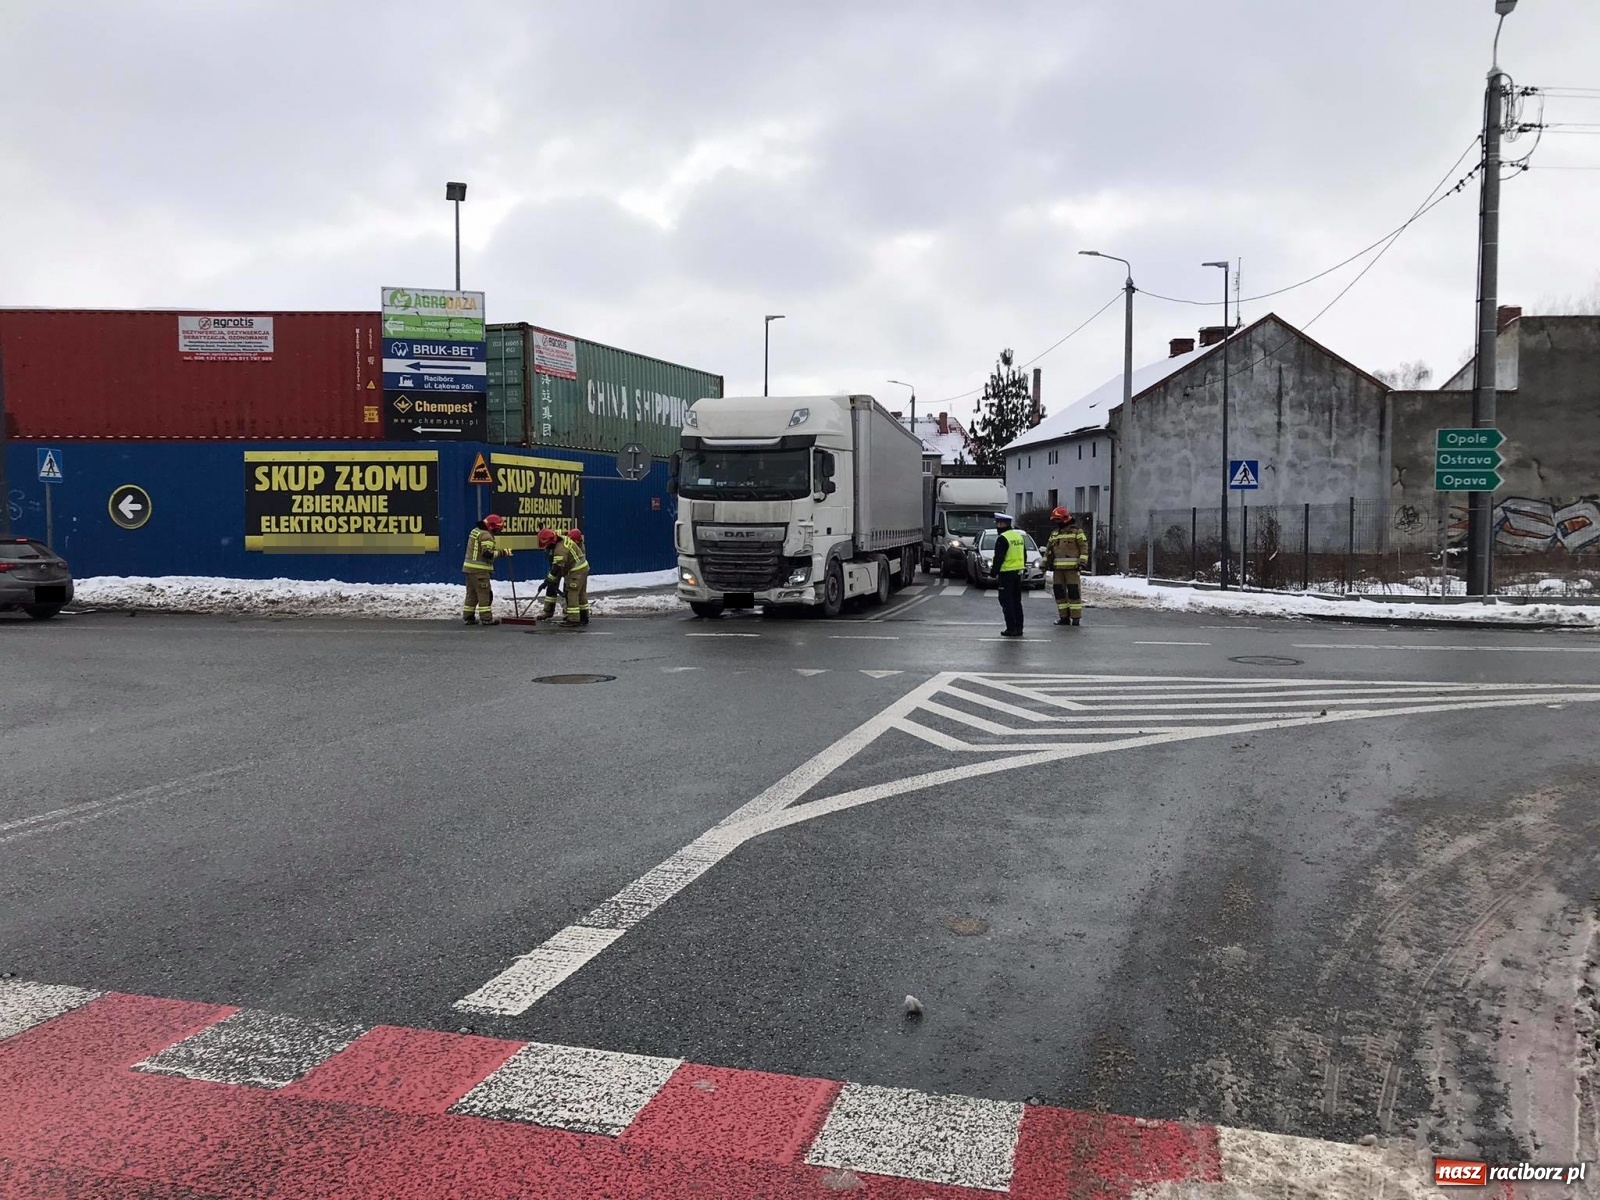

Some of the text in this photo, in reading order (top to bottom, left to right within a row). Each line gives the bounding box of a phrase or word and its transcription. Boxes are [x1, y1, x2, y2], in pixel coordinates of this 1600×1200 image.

[413, 344, 475, 356] BRUK-BET
[415, 400, 474, 415] Chempest
[588, 379, 628, 420] CHINA
[393, 418, 479, 426] www.chempest.pl
[1446, 433, 1488, 446] Opole
[1440, 454, 1492, 464] Ostrava
[255, 465, 428, 491] SKUP ZŁOMU
[497, 468, 536, 493] SKUP
[1442, 475, 1487, 488] Opava
[291, 495, 389, 513] ZBIERANIE
[518, 497, 563, 515] ZBIERANIE
[260, 516, 423, 534] ELEKTROSPRZĘTU
